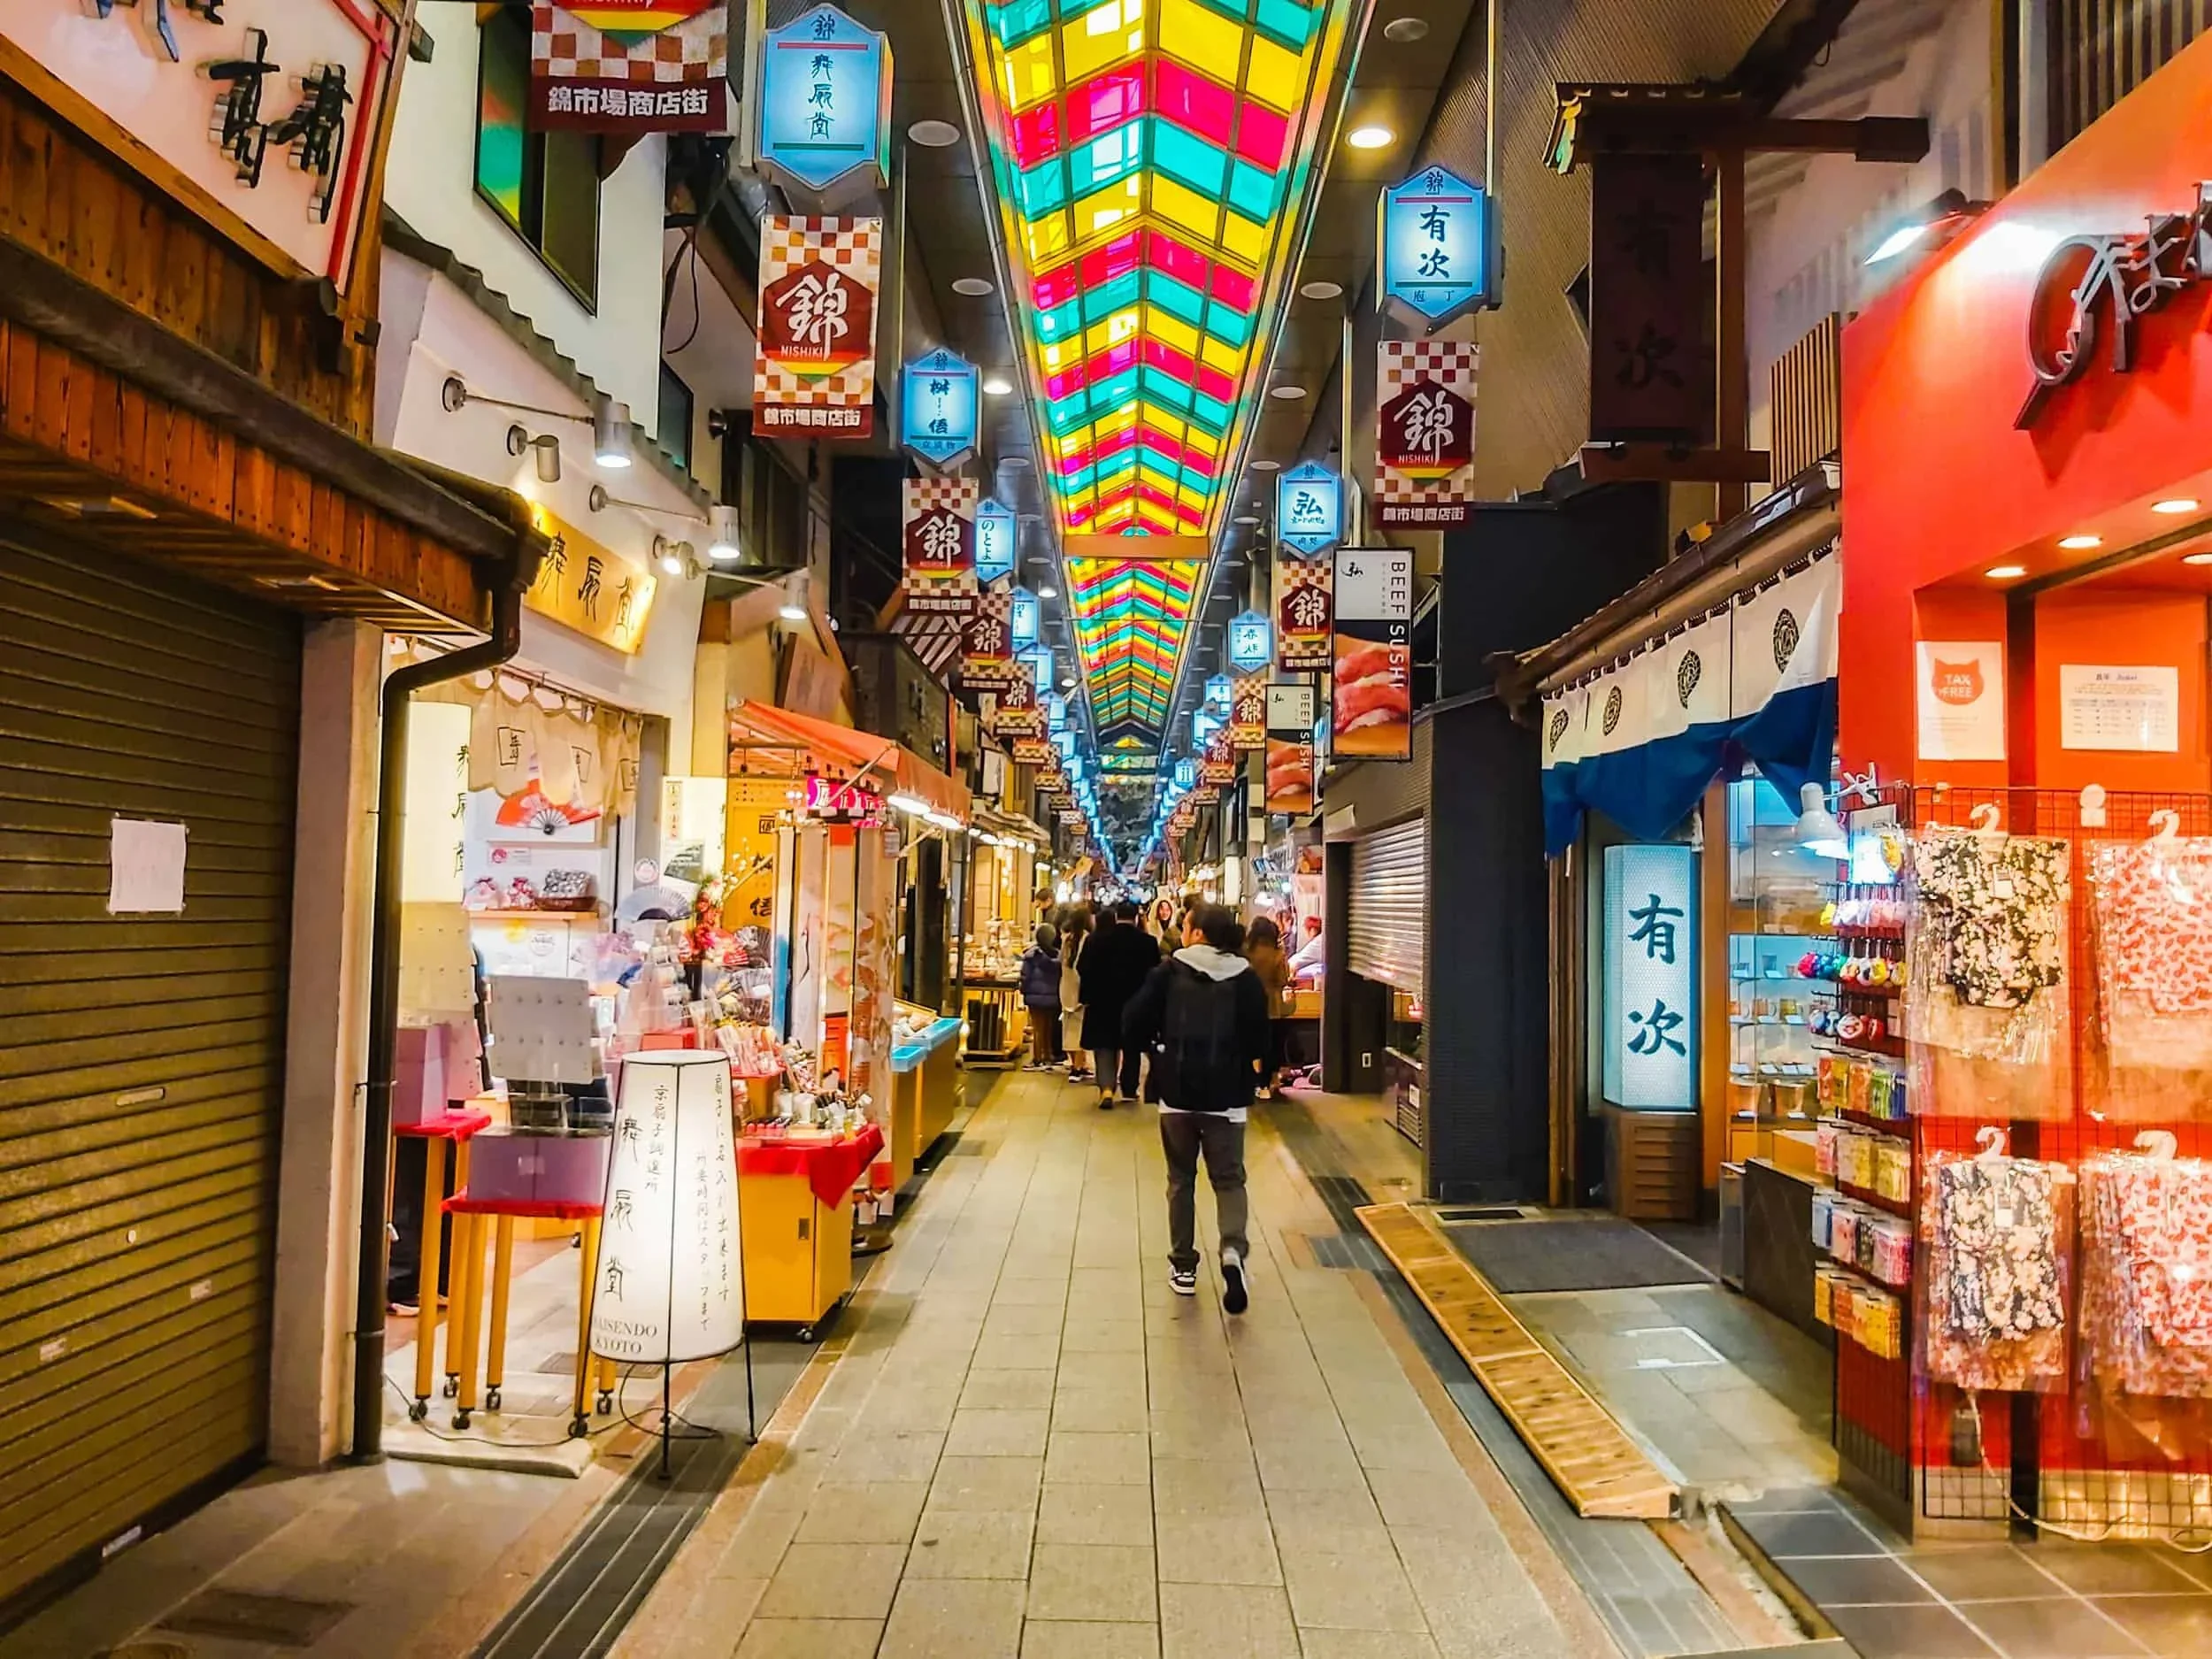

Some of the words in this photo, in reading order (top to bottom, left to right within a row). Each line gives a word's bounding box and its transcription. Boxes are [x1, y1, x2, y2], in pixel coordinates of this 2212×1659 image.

[549, 86, 708, 117] 錦市場商店街
[1417, 204, 1451, 279] 有次
[775, 273, 849, 362] 錦
[780, 346, 824, 357] NISHIKI
[1394, 390, 1454, 467] 錦
[1398, 454, 1433, 464] NISHIKI
[1293, 491, 1324, 516] 弘
[915, 514, 962, 569] 錦
[981, 519, 995, 561] のとよ
[1391, 562, 1406, 614] BEEF
[1287, 588, 1325, 634] 錦
[970, 619, 1002, 659] 錦
[1388, 625, 1405, 688] SUSHI
[1945, 673, 1972, 686] TAX
[1236, 696, 1262, 727] 錦
[1301, 693, 1310, 726] BEEF
[1300, 732, 1310, 771] SUSHI
[1628, 894, 1686, 1056] 有次
[594, 1336, 642, 1354] KYOTO
